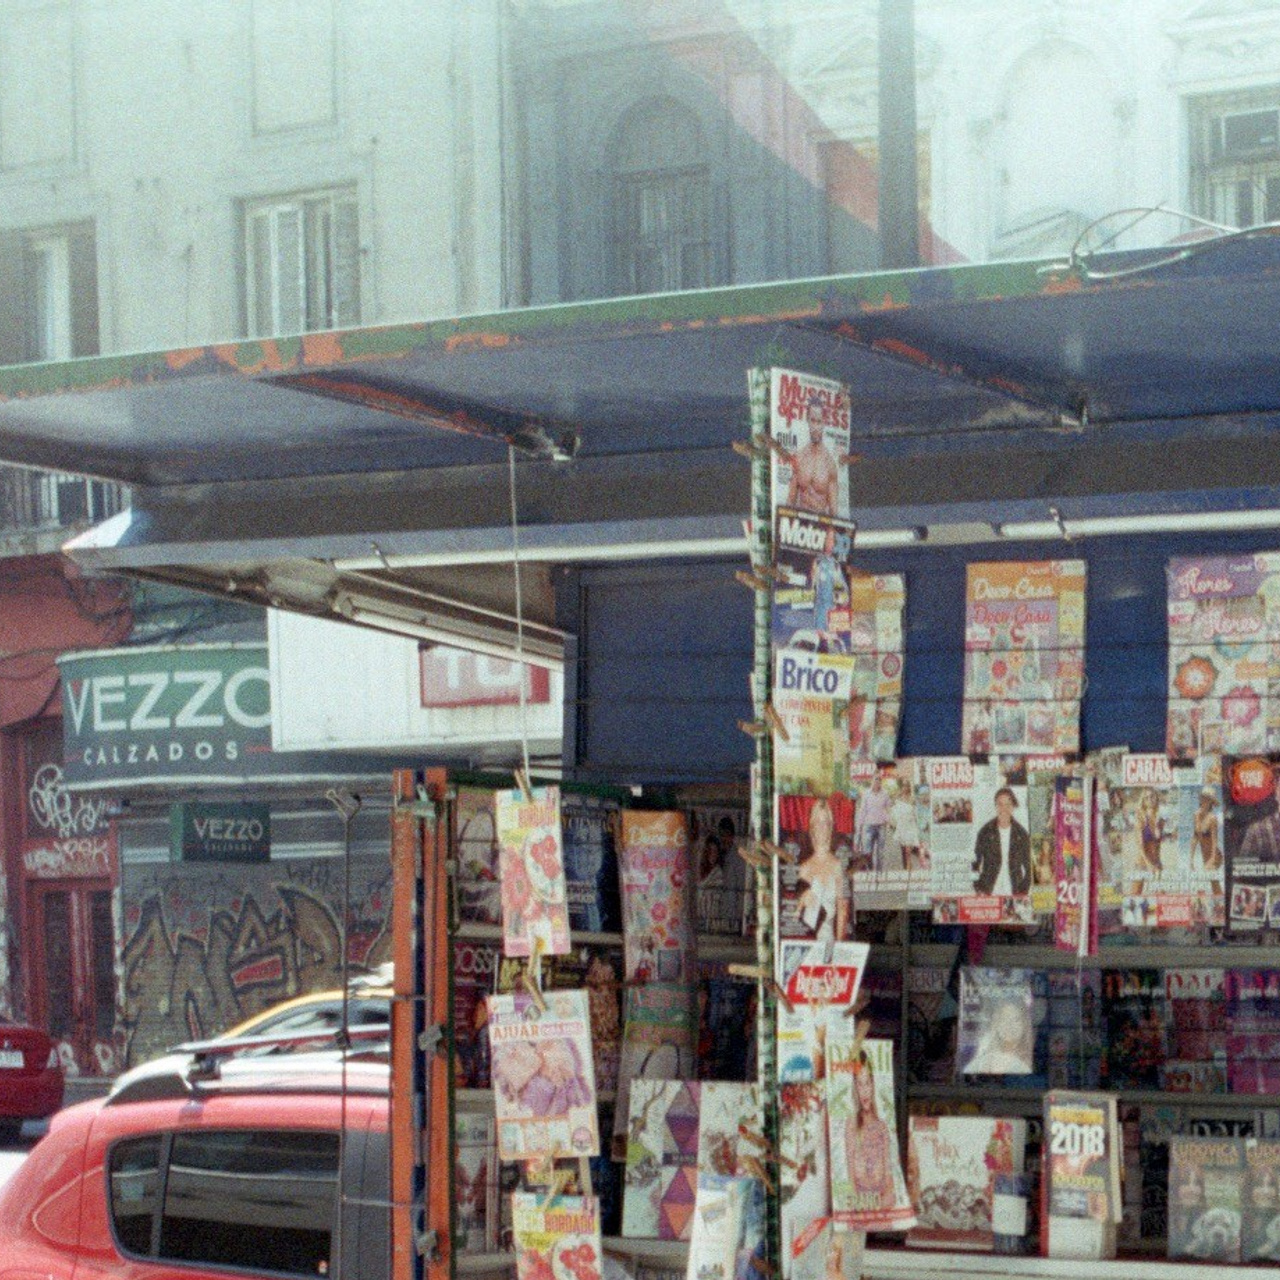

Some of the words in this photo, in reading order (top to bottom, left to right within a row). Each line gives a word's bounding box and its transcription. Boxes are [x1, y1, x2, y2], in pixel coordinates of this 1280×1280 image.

[781, 658, 838, 694] Brico
[65, 667, 271, 735] VEZZO
[83, 738, 239, 766] CALZADOS
[193, 815, 263, 841] VEZZO
[1051, 1123, 1105, 1157] 2018
